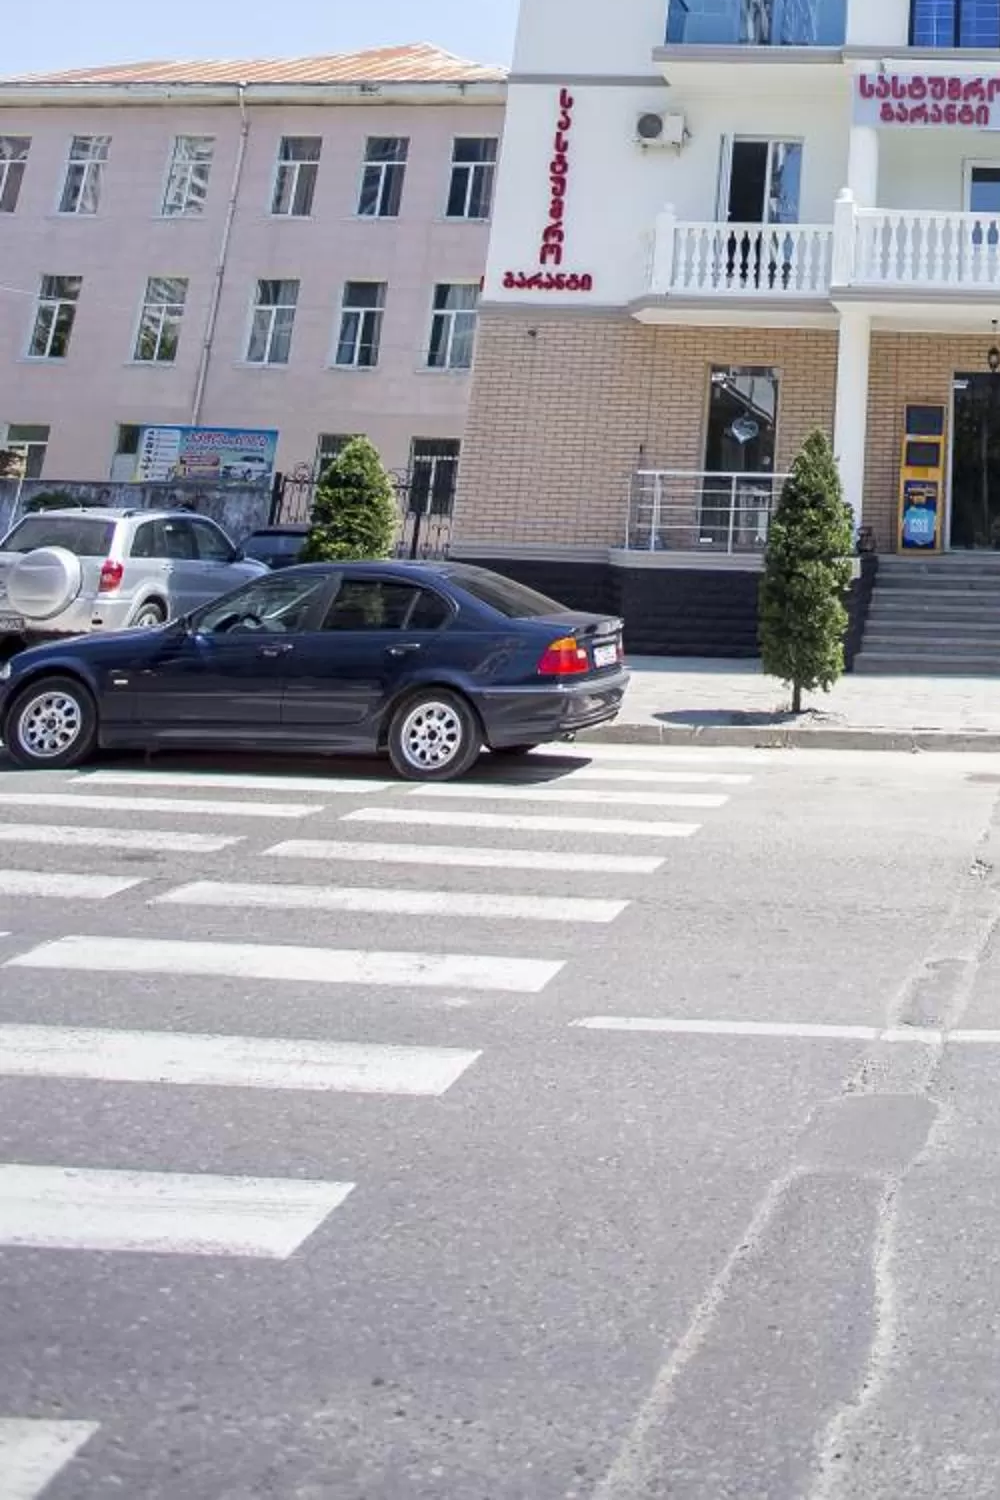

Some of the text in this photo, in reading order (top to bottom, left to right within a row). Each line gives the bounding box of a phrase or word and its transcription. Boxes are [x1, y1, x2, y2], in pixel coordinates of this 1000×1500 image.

[880, 102, 990, 126] გარანტი
[539, 88, 574, 265] სასტუმრო
[503, 271, 593, 291] გარანტი
